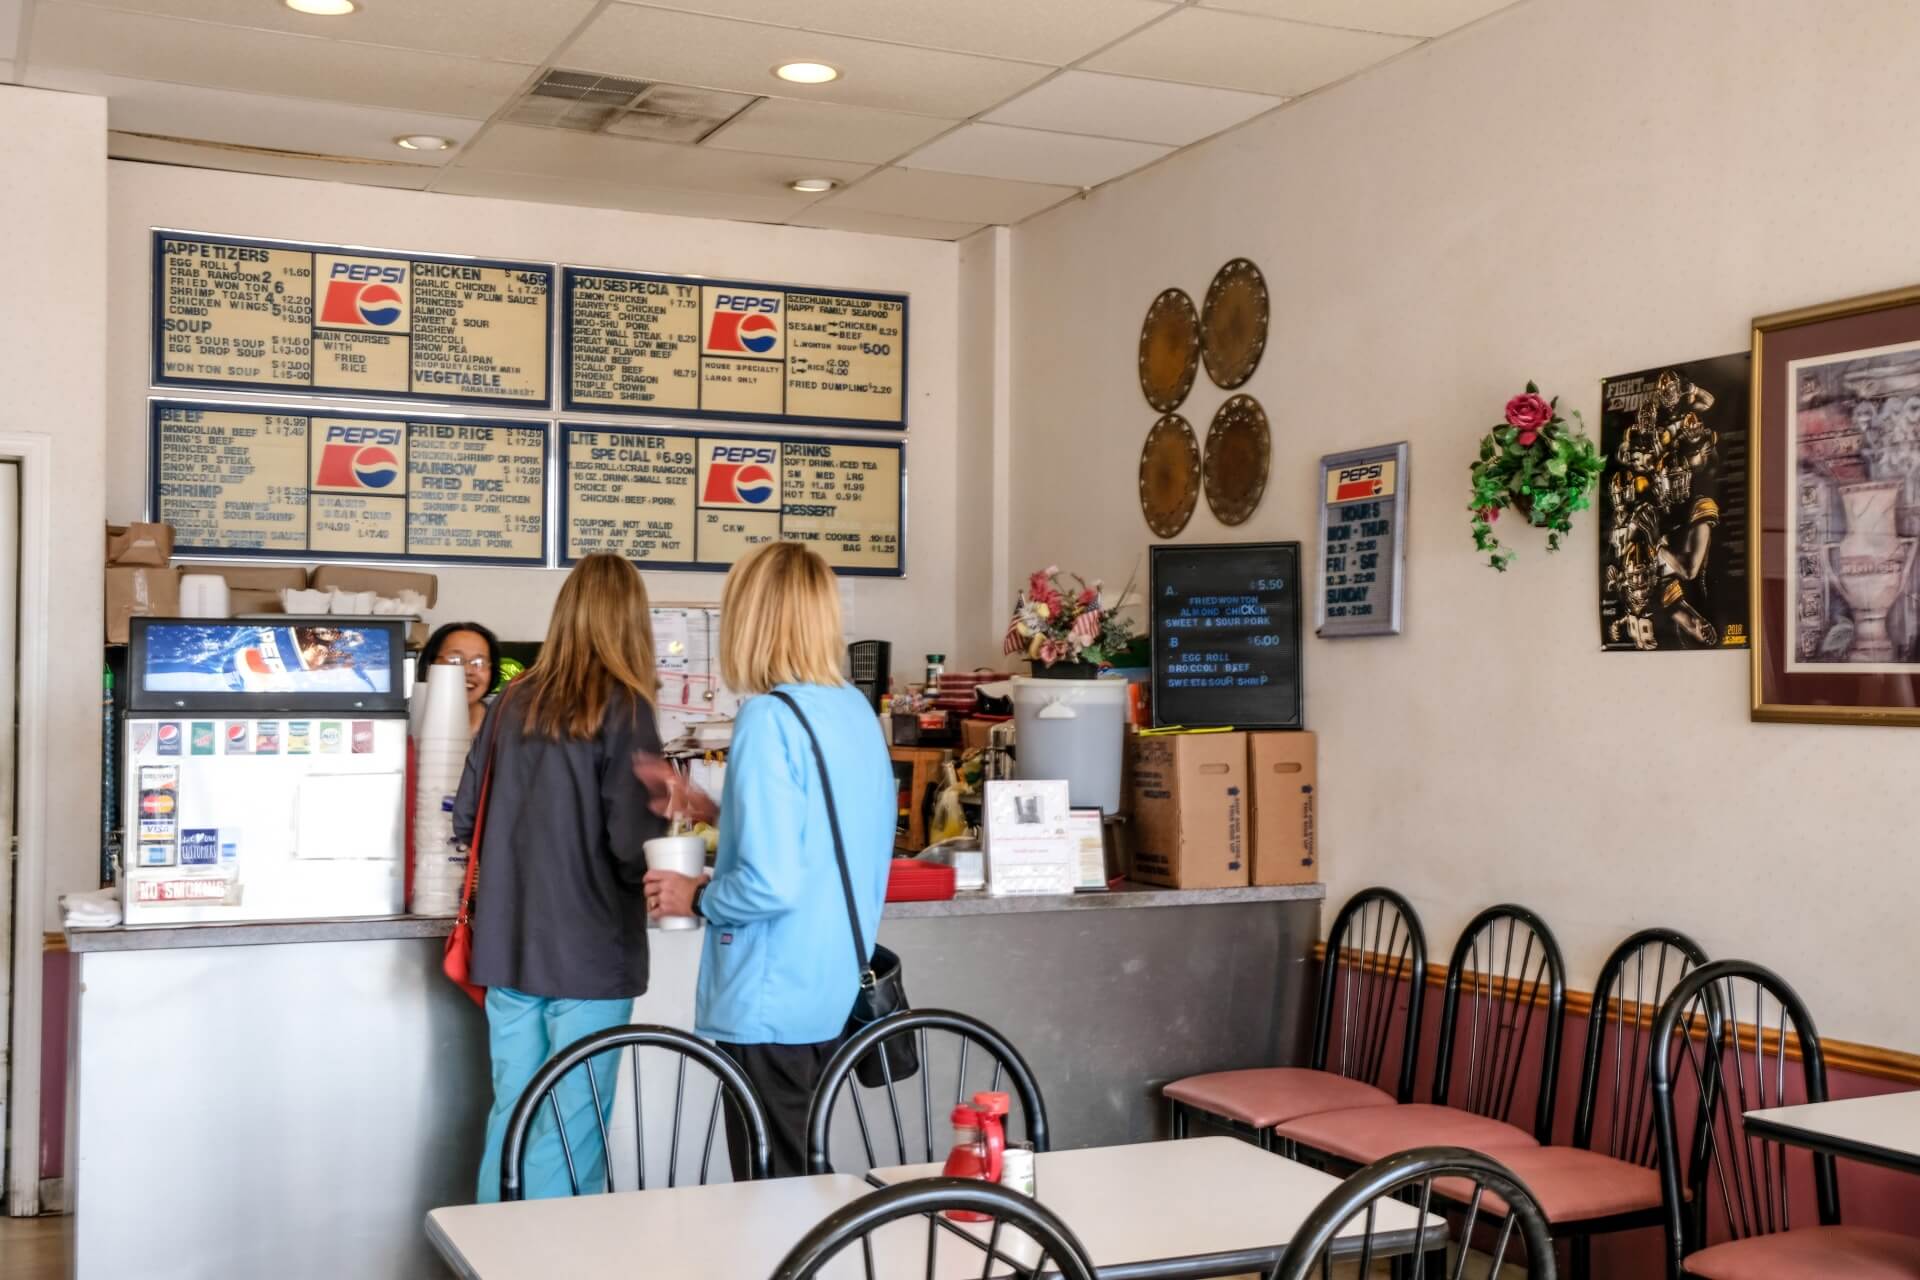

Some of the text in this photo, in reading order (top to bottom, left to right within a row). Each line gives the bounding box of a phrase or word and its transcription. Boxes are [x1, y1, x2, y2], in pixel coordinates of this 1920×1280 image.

[166, 242, 269, 262] APPETIZERS
[170, 258, 228, 270] EGG ROLL
[170, 268, 271, 283] CRAB RANGOON 2
[331, 263, 405, 284] PEPSI
[414, 264, 481, 280] CHICKEN
[171, 278, 284, 294] FRIED WON TON 6
[415, 279, 496, 292] GARLIC CHICKEN
[170, 287, 261, 301] SHRIMP TOAST
[415, 288, 537, 305] CHICKEN PLUM SAUCE
[609, 294, 648, 304] CHICKEN
[170, 296, 282, 316] CHICKEN WINGS 5
[415, 298, 464, 308] PRINCESS
[575, 301, 666, 314] HARVEY'S CHICKEN
[716, 294, 780, 313] PEPSI
[788, 295, 872, 308] SZECHUAN SCALLOP
[170, 306, 208, 316] COMBO
[415, 307, 456, 317] ALMOND
[575, 310, 658, 322] ORANGE CHICKEN
[787, 304, 888, 318] HAPPY FAMILY SEAFOOD
[165, 320, 212, 333] SOUP
[414, 315, 490, 328] SWEET SOUR
[626, 322, 650, 330] PORK
[788, 321, 877, 332] SESAME CHICKEN
[415, 325, 455, 334] CASHEW
[574, 328, 662, 340] GREAT WALL STEAK
[839, 331, 862, 340] BEEF
[169, 335, 265, 348] HOT SOUR SOUP
[315, 331, 390, 344] MAIN COURSES
[415, 334, 464, 344] BROCCOLI
[574, 336, 602, 346] GREAT
[605, 338, 628, 346] WALL
[169, 344, 266, 358] EGG DROP SOUP
[324, 342, 352, 352] WITH
[414, 343, 443, 352] SNOW
[575, 345, 609, 354] ORANGE
[614, 348, 646, 356] FLAVOR
[335, 354, 366, 363] FRIED
[575, 354, 606, 363] HUNAN
[166, 363, 260, 376] WON TON SOUP
[341, 363, 367, 372] RICE
[576, 363, 616, 371] SCALLOP
[737, 364, 779, 373] SPECIALTY
[415, 370, 501, 386] VEGETABLE
[575, 372, 614, 381] PHOENIX
[575, 381, 646, 391] TRIPLE CROWN
[789, 380, 868, 392] FRIED DUMPLING
[574, 389, 613, 398] BRAISED
[161, 409, 204, 423] BEEF
[164, 425, 257, 436] MONGOLIAN BEEF
[326, 426, 401, 445] PEPSI
[408, 425, 494, 441] FRIED RICE
[164, 434, 235, 445] MING'S BEEF
[570, 434, 665, 449] LITE DINNER
[163, 444, 217, 454] PRINCESS
[591, 448, 650, 462] SPECIAL
[784, 445, 831, 457] DRINKS
[164, 453, 251, 465] PEPPER STEAK
[712, 447, 776, 464] PEPSI
[163, 464, 222, 473] SNOW PEA
[784, 458, 806, 467] SOFT
[409, 462, 477, 476] RAINBOW
[1340, 464, 1382, 483] PEPSI
[162, 473, 216, 482] BROCCOLI
[422, 476, 503, 492] FRIED RICE
[160, 484, 223, 498] SHRIMP
[783, 504, 837, 516] DESSERT
[408, 512, 447, 526] PORK
[573, 519, 616, 527] COUPONS
[636, 530, 672, 538] SPECIAL
[783, 532, 860, 542] FORTUNE COOKIES
[662, 541, 680, 549] NOT
[843, 544, 861, 552] BAG
[1327, 586, 1368, 604] SUNDAY
[1181, 607, 1220, 616] ALMOND
[1166, 619, 1197, 628] SWEET
[1170, 638, 1178, 648] B
[1168, 664, 1216, 673] BROCCOLI
